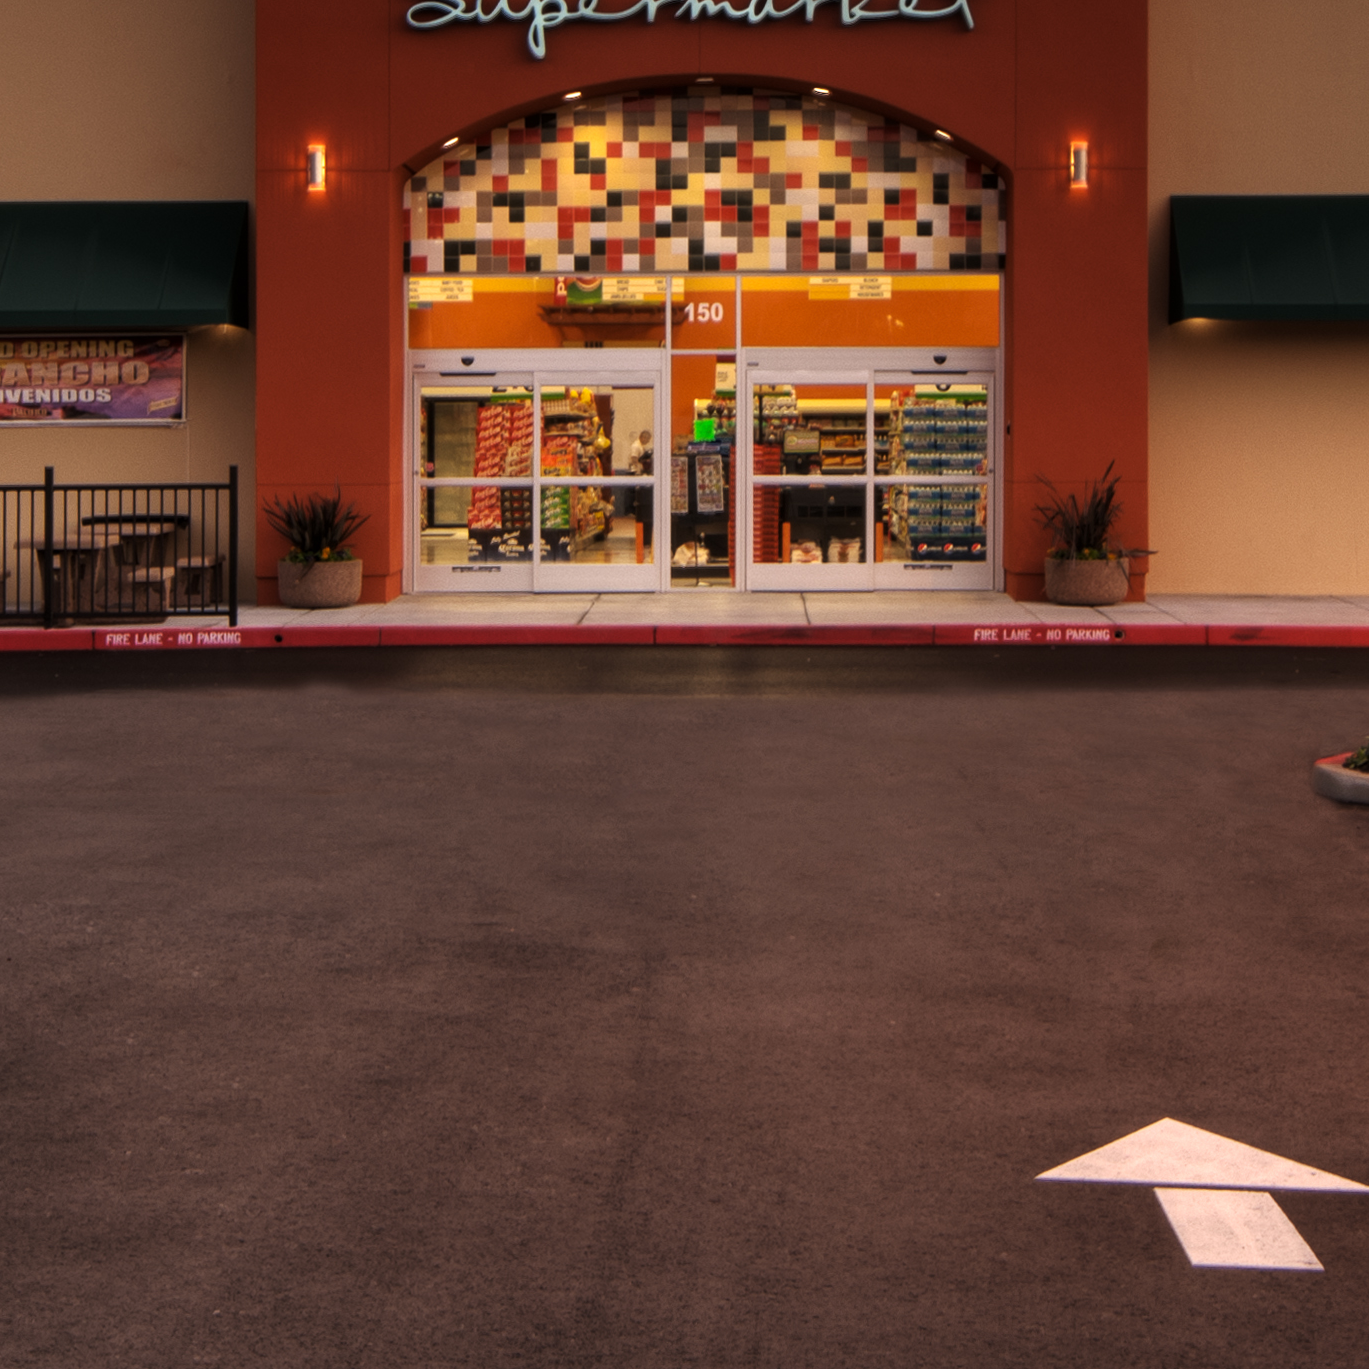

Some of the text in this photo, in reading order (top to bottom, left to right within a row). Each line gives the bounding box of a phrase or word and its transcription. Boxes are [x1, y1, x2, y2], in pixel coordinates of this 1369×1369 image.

[684, 302, 724, 322] 150
[21, 339, 134, 358] OPENING
[105, 633, 131, 646] FIRE
[134, 633, 164, 646] LANE
[177, 632, 193, 645] NO
[197, 631, 242, 644] PARKING
[973, 628, 999, 641] FIRE
[1003, 628, 1032, 641] LANE
[1046, 628, 1062, 641] NO
[1066, 628, 1110, 641] PARKING
